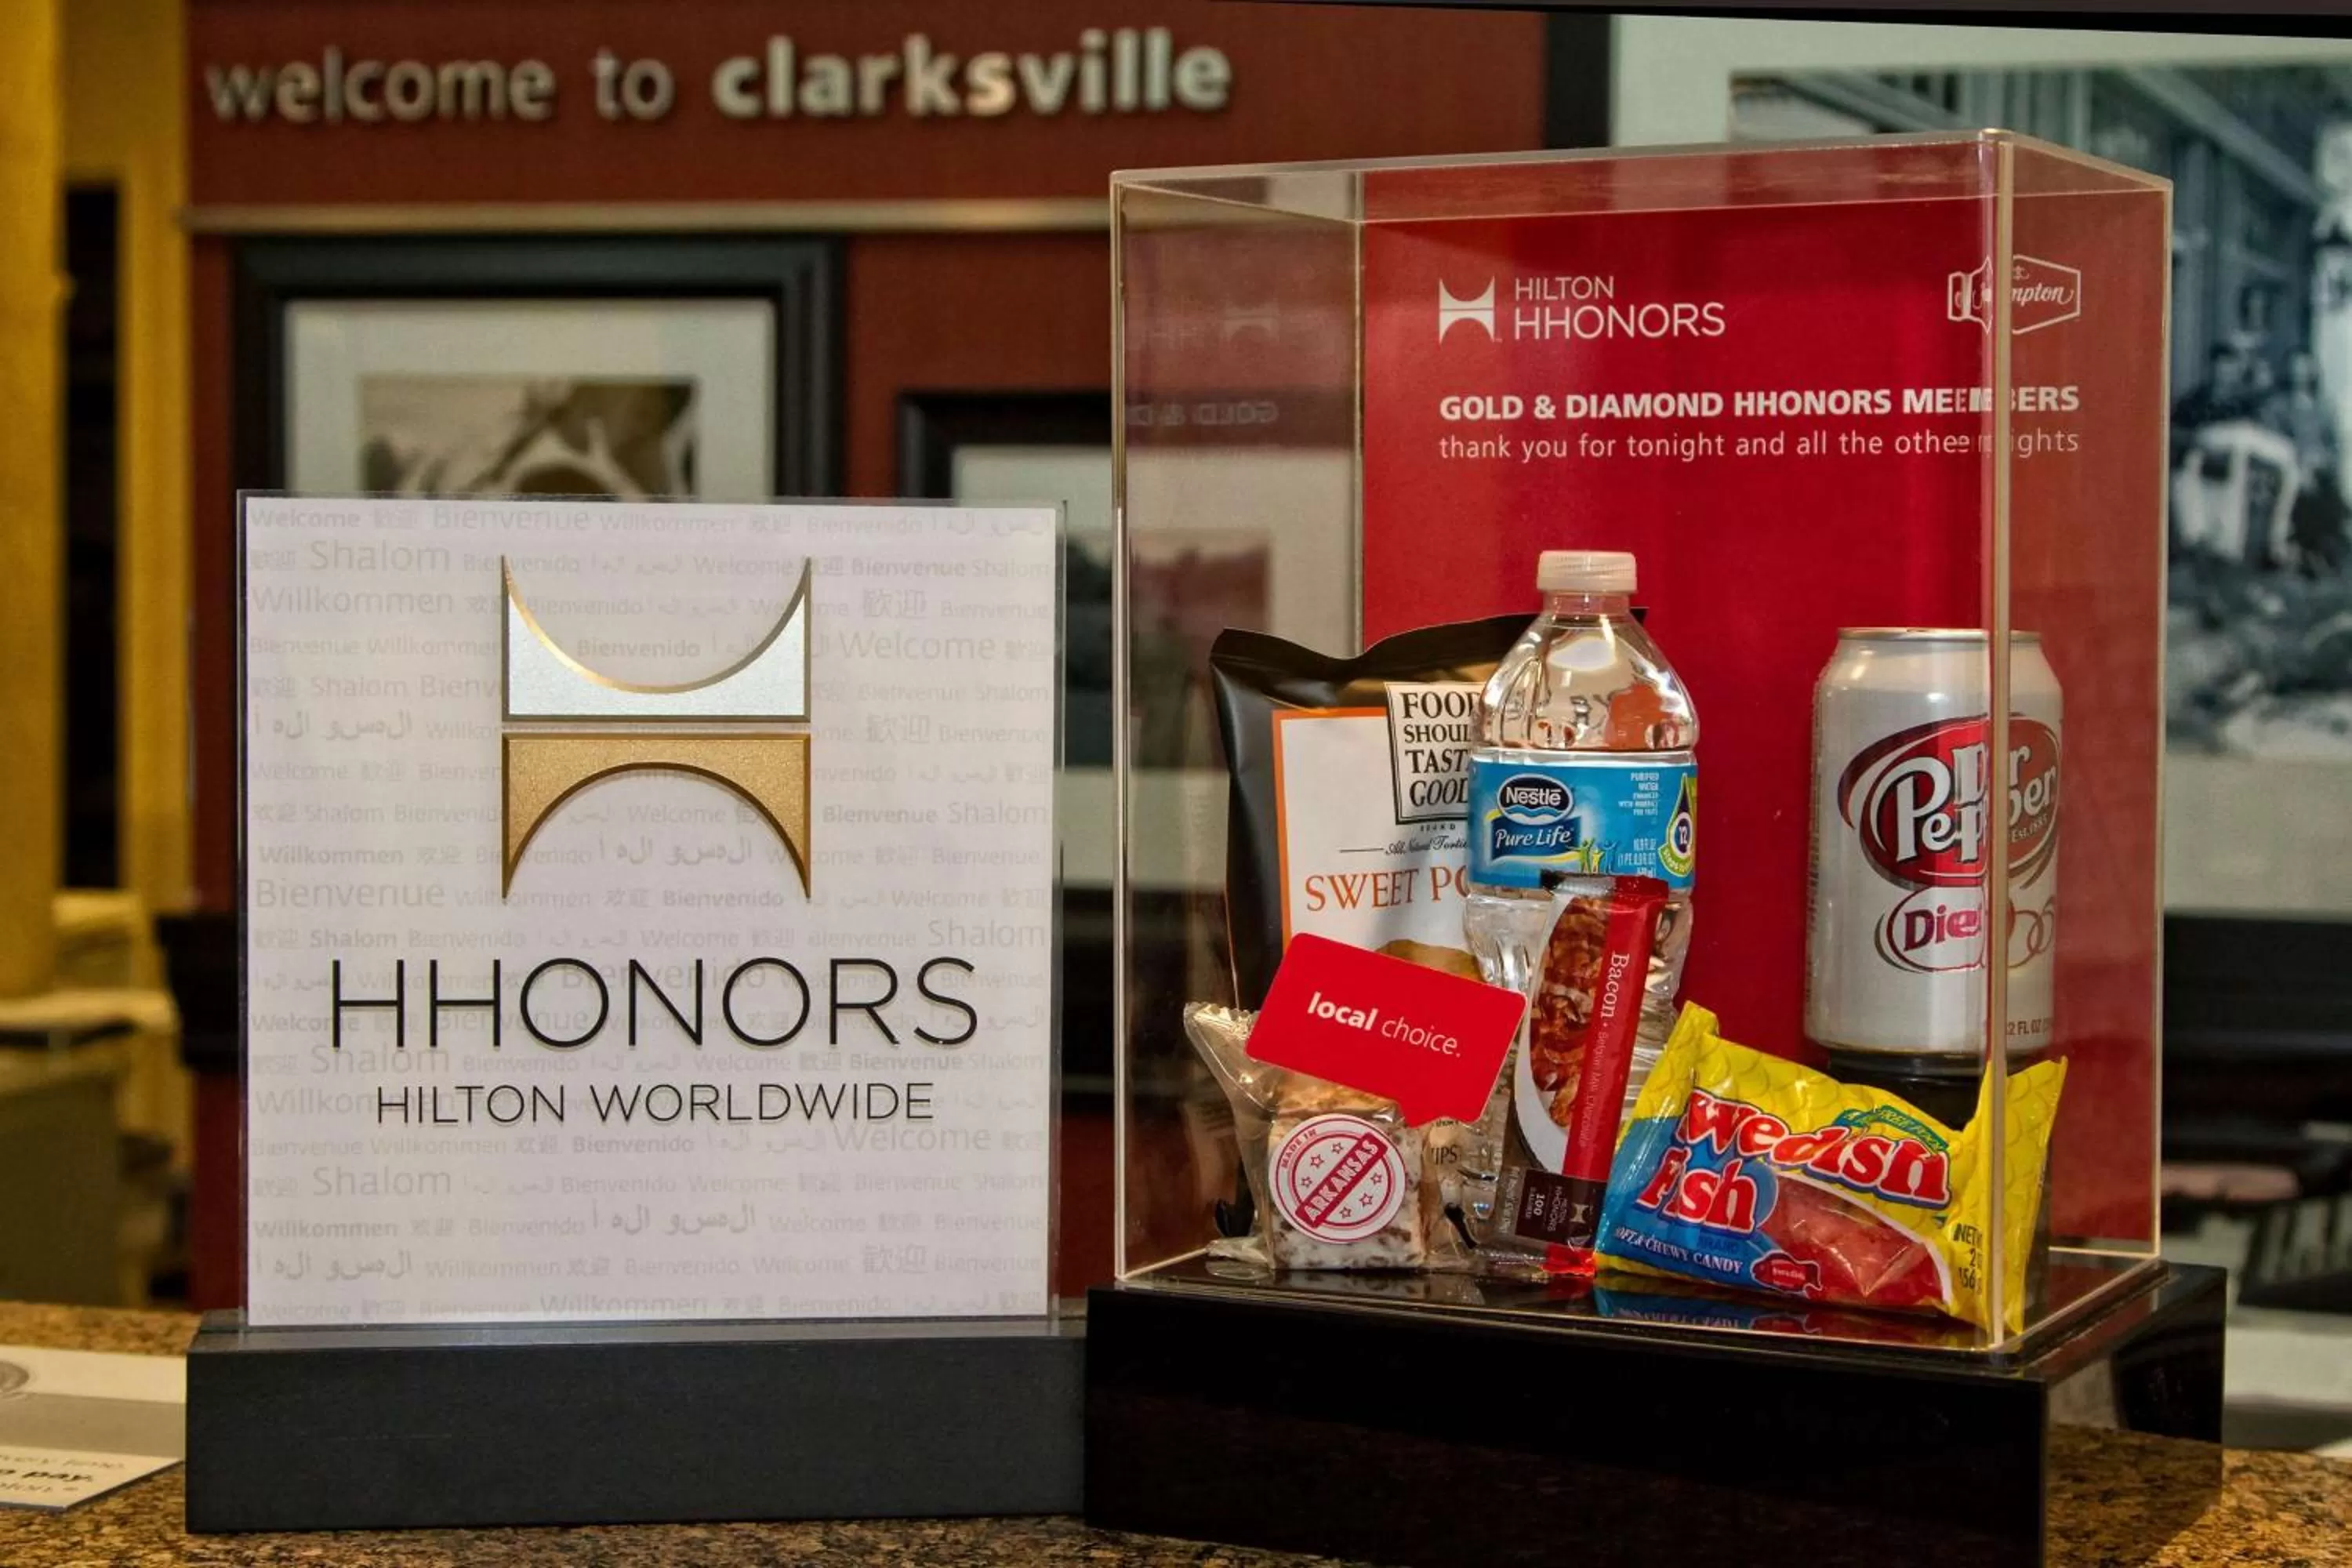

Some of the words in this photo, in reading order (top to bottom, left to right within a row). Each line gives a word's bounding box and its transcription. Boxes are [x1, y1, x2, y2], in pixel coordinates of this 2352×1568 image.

[206, 45, 554, 122] welcome
[592, 47, 673, 118] to
[712, 28, 1232, 120] clarksville
[1515, 275, 1614, 300] HILTON
[1515, 303, 1725, 339] HHONORS
[1439, 395, 1523, 420] GOLD
[1533, 394, 1556, 420] &
[1566, 392, 1723, 419] DIAMOND
[1734, 390, 1892, 416] HHONORS
[1439, 434, 1511, 459] thank
[1522, 438, 1567, 463] you
[1579, 433, 1617, 458] for
[1627, 432, 1725, 463] tonight
[1735, 430, 1785, 456] and
[1796, 430, 1828, 456] all
[1839, 429, 1883, 455] the
[1894, 428, 1970, 455] othe
[310, 539, 451, 572] Shalom
[252, 586, 453, 615] Willkommen
[839, 630, 996, 660] Welcome
[1403, 724, 1471, 743] SHOUL
[1404, 748, 1471, 774] TAST
[1495, 829, 1534, 849] Pure
[1536, 825, 1572, 848] Life
[256, 877, 446, 909] Bienvenue
[1305, 868, 1419, 912] SWEET
[927, 919, 1046, 949] Shalom
[1903, 903, 1984, 952] Die
[1600, 950, 1630, 1018] Bacon
[332, 956, 978, 1051] HHONORS
[1307, 991, 1379, 1032] local
[376, 1085, 564, 1126] HILTON
[589, 1083, 935, 1123] WORLDWIDE
[313, 1166, 452, 1197] Shalom
[1304, 1139, 1379, 1221] ARKANSAS
[1636, 1146, 1759, 1235] Fsh
[1533, 1193, 1546, 1216] 100
[1646, 1235, 1690, 1262] CHEWY
[1693, 1253, 1744, 1275] CANDY
